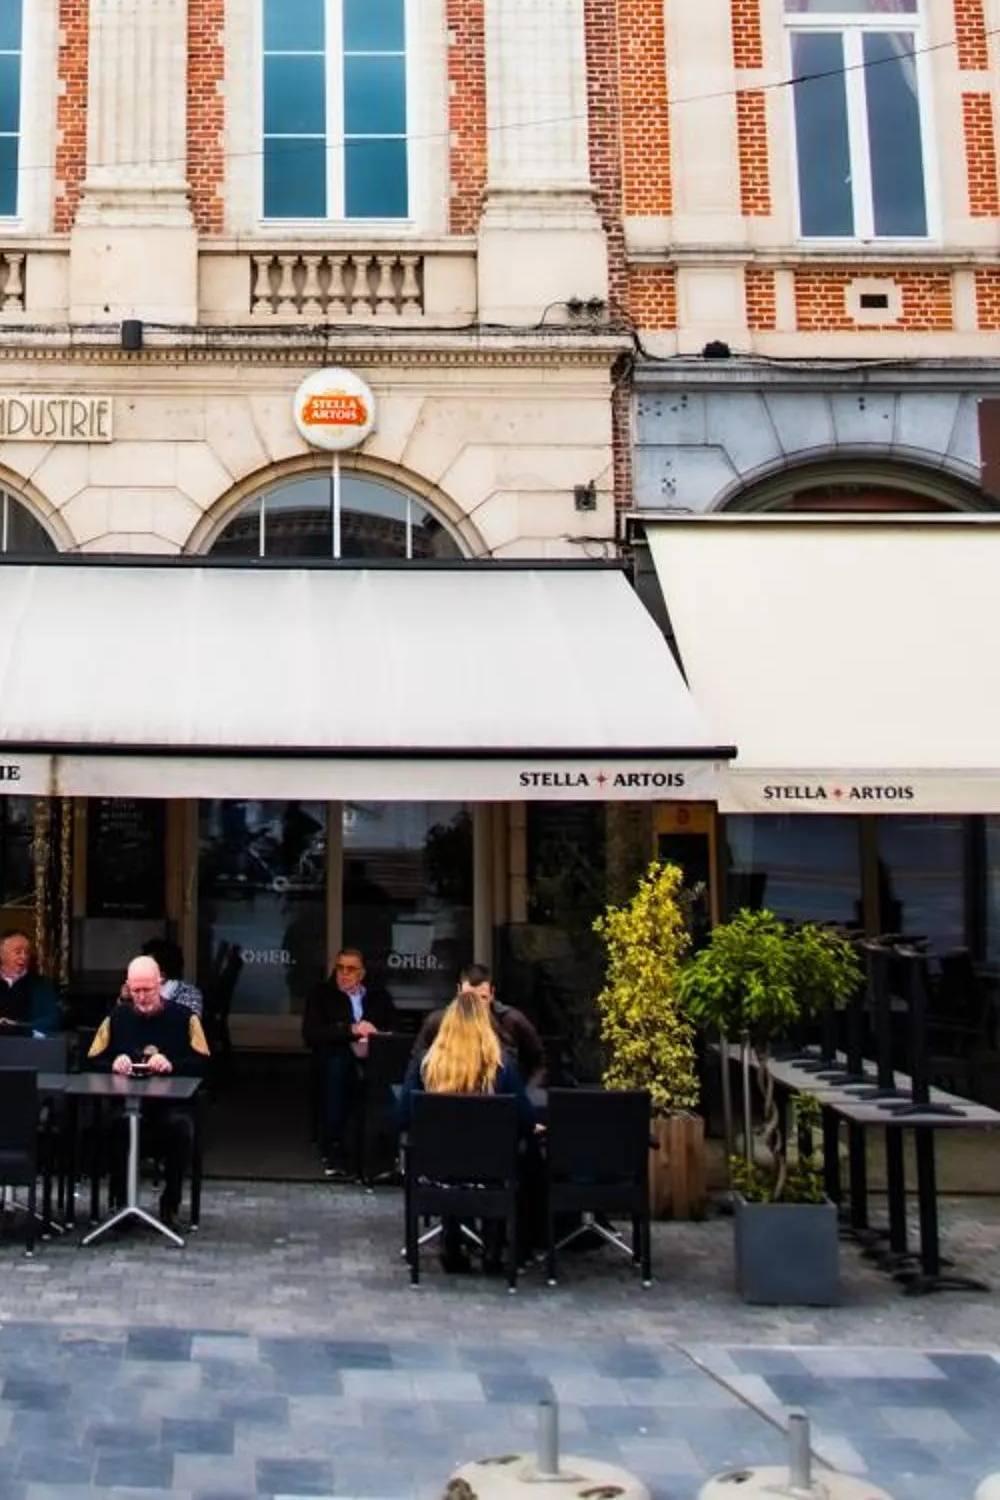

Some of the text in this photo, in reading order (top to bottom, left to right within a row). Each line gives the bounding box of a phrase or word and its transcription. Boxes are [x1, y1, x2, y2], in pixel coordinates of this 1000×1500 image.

[311, 399, 358, 409] STELLA
[311, 409, 359, 420] ARTOIS
[519, 771, 685, 788] STELLA ARTOIS
[763, 785, 915, 800] STELLA ARTOIS
